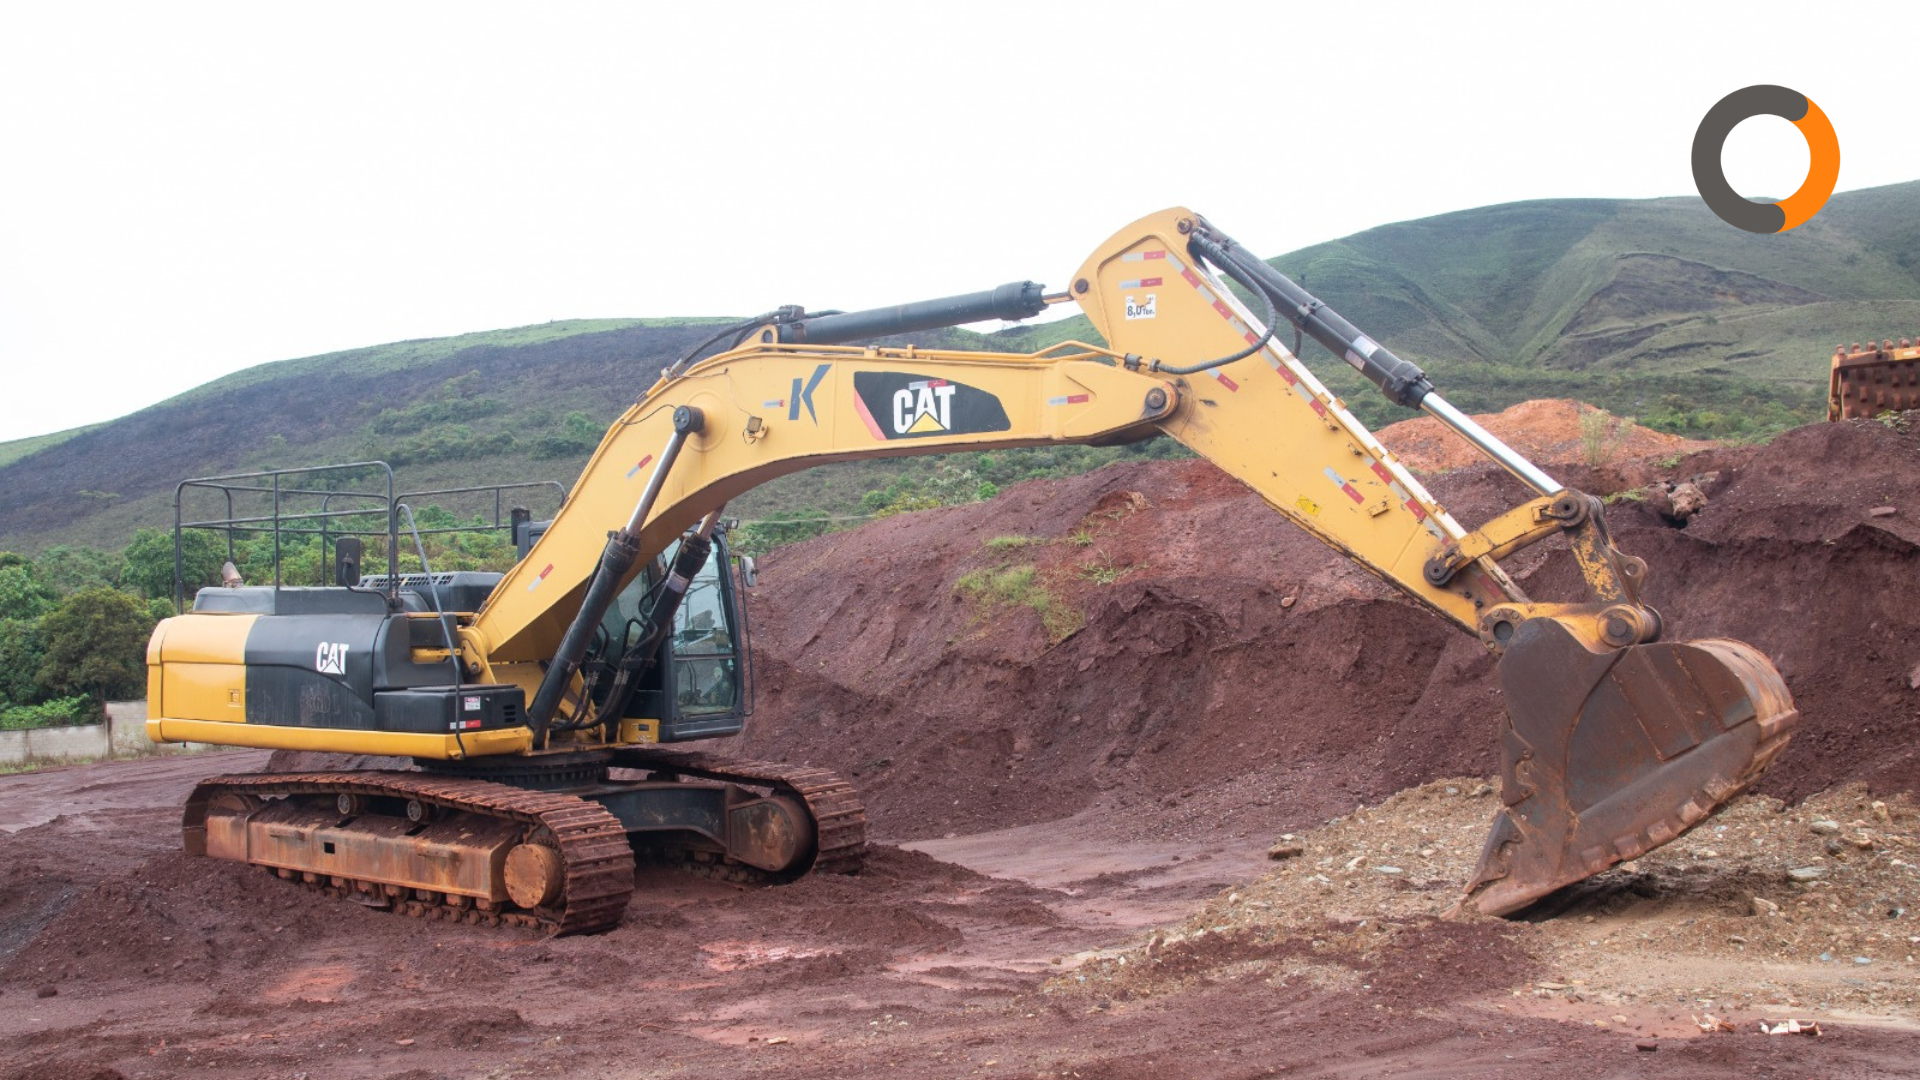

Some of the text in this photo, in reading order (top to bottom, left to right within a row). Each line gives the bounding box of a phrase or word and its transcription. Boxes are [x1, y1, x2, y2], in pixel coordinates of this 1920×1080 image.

[788, 363, 832, 427] K
[893, 384, 956, 434] CAT
[316, 641, 350, 675] CAT
